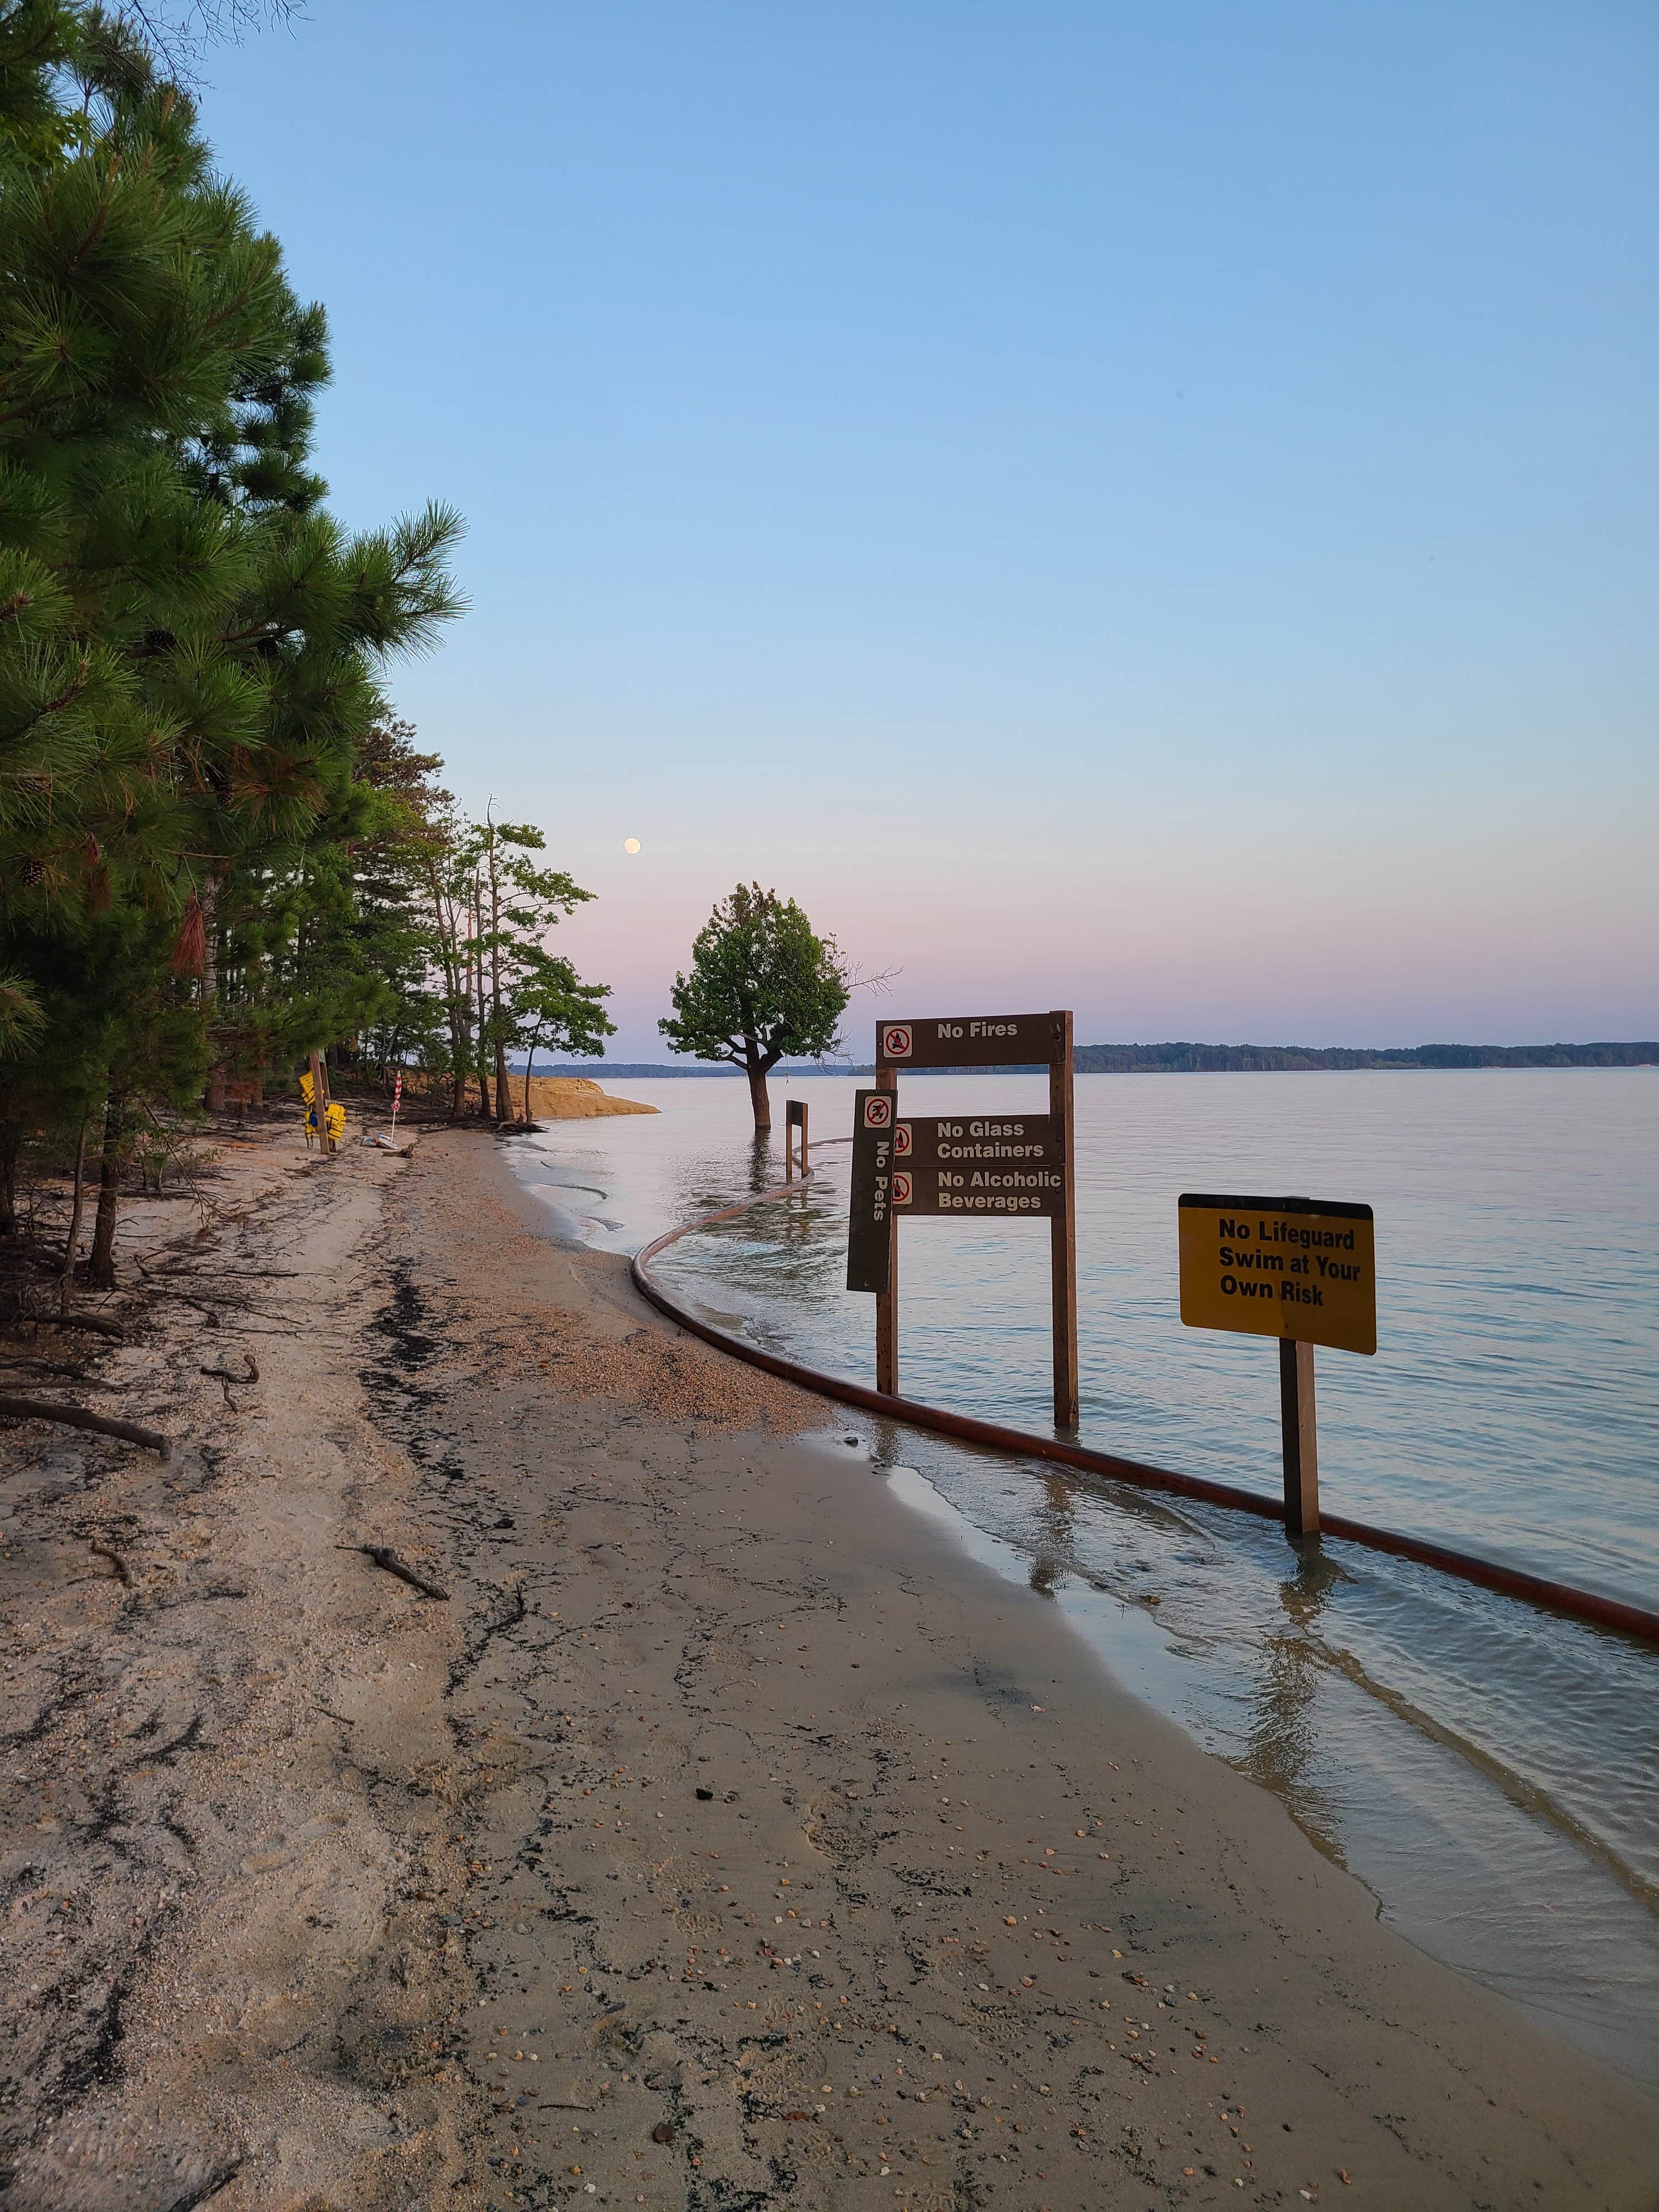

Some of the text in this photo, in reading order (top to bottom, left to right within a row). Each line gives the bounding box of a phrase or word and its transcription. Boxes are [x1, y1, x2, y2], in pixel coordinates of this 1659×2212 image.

[938, 1022, 1018, 1038] No Fires
[938, 1122, 1024, 1137] No Glass
[938, 1142, 1043, 1158] Containers
[873, 1141, 890, 1221] No Pets
[938, 1171, 1061, 1187] No Alcoholic
[939, 1193, 1041, 1211] Beverages
[1219, 1219, 1354, 1250] No Lifeguard
[1220, 1247, 1360, 1281] Swim at Your
[1221, 1276, 1323, 1306] Own Risk
